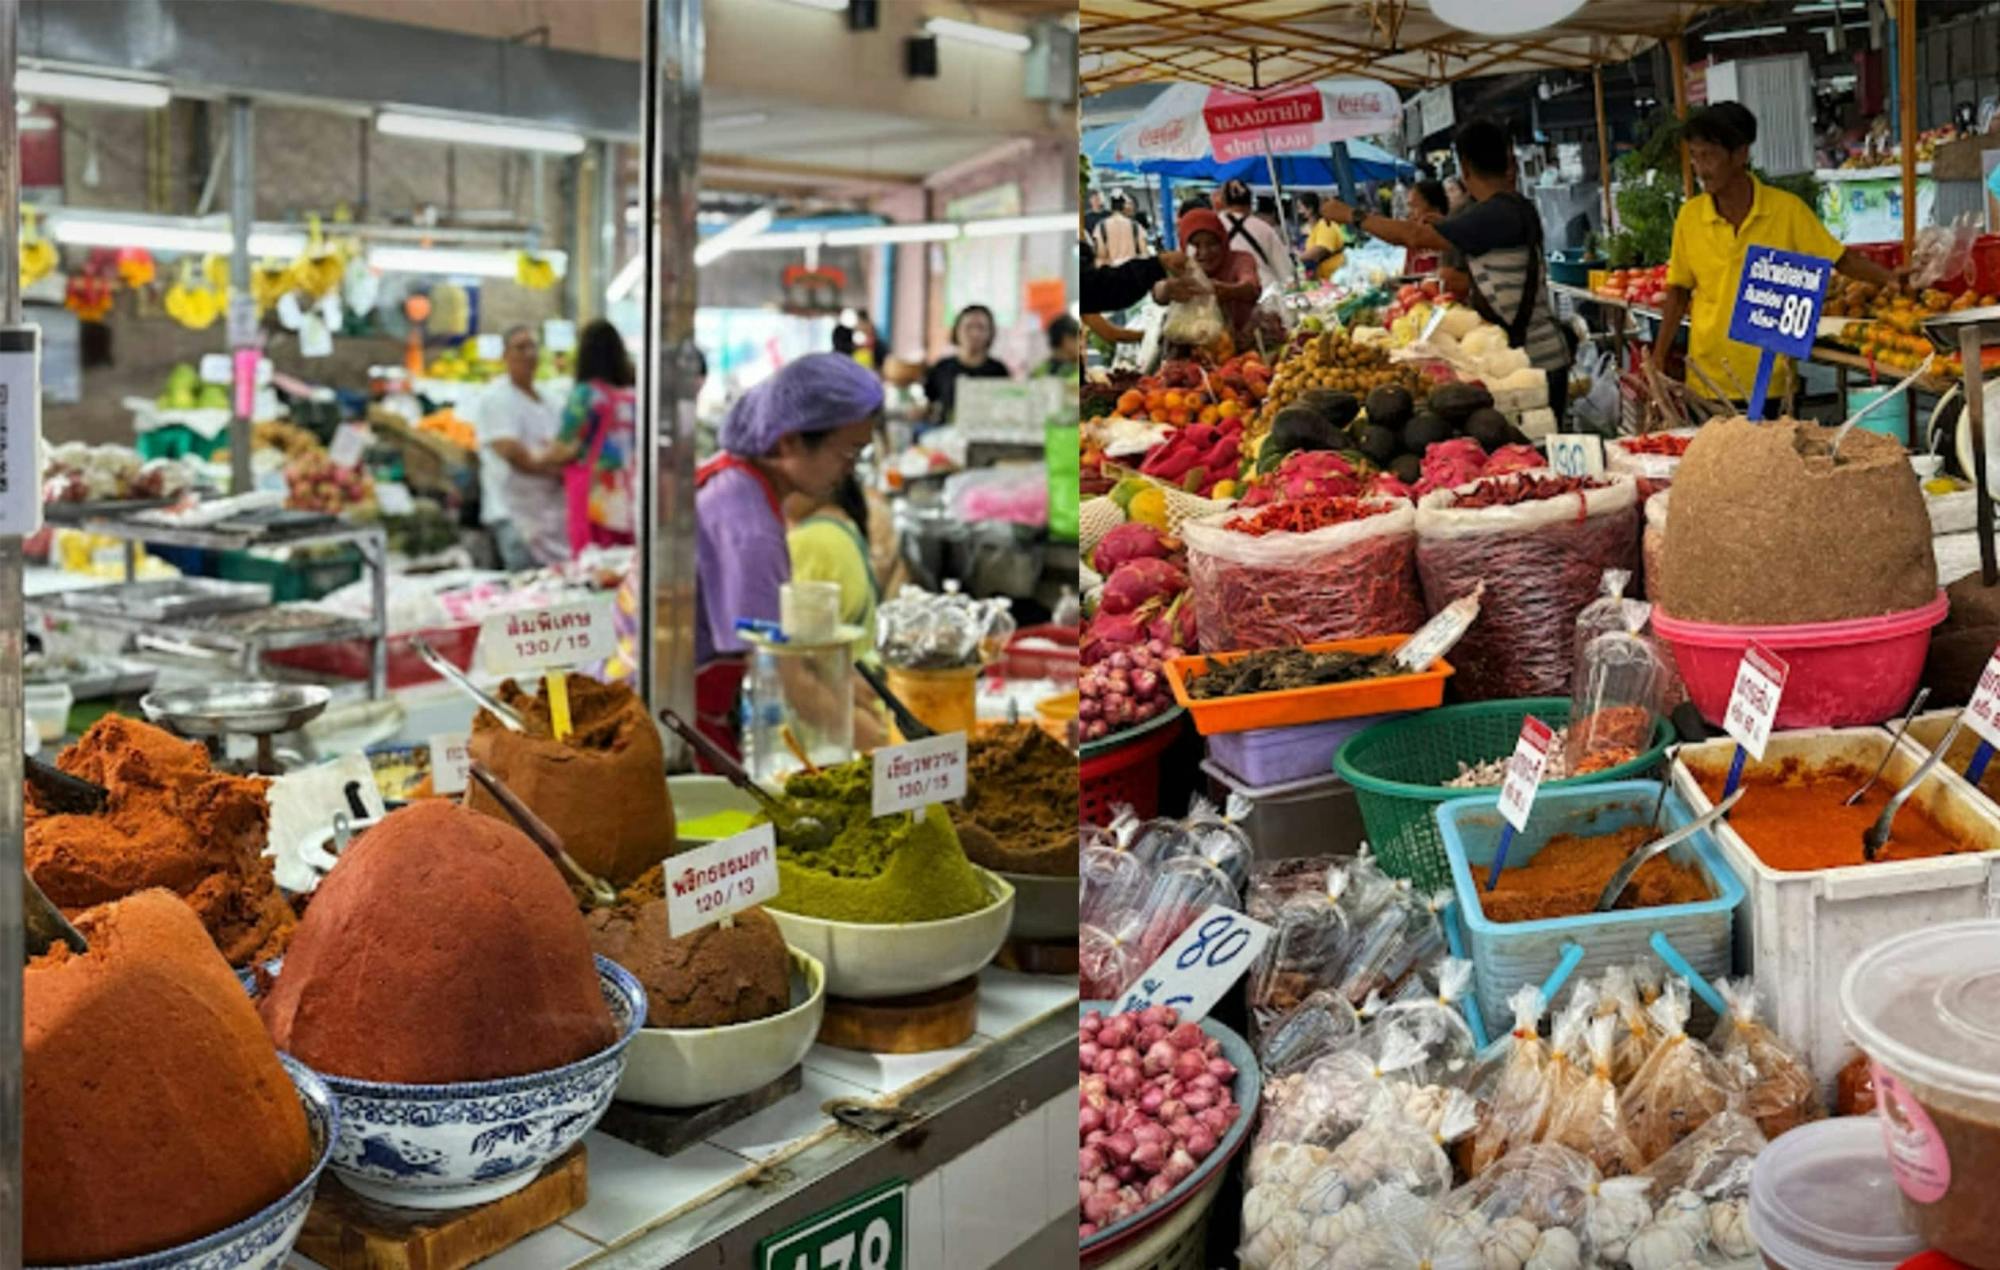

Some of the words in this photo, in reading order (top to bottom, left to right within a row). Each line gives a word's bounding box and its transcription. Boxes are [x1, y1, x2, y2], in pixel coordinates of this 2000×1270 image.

[1779, 293, 1813, 339] 80
[887, 752, 959, 779] เขียวหวาน
[1176, 915, 1250, 969] 80
